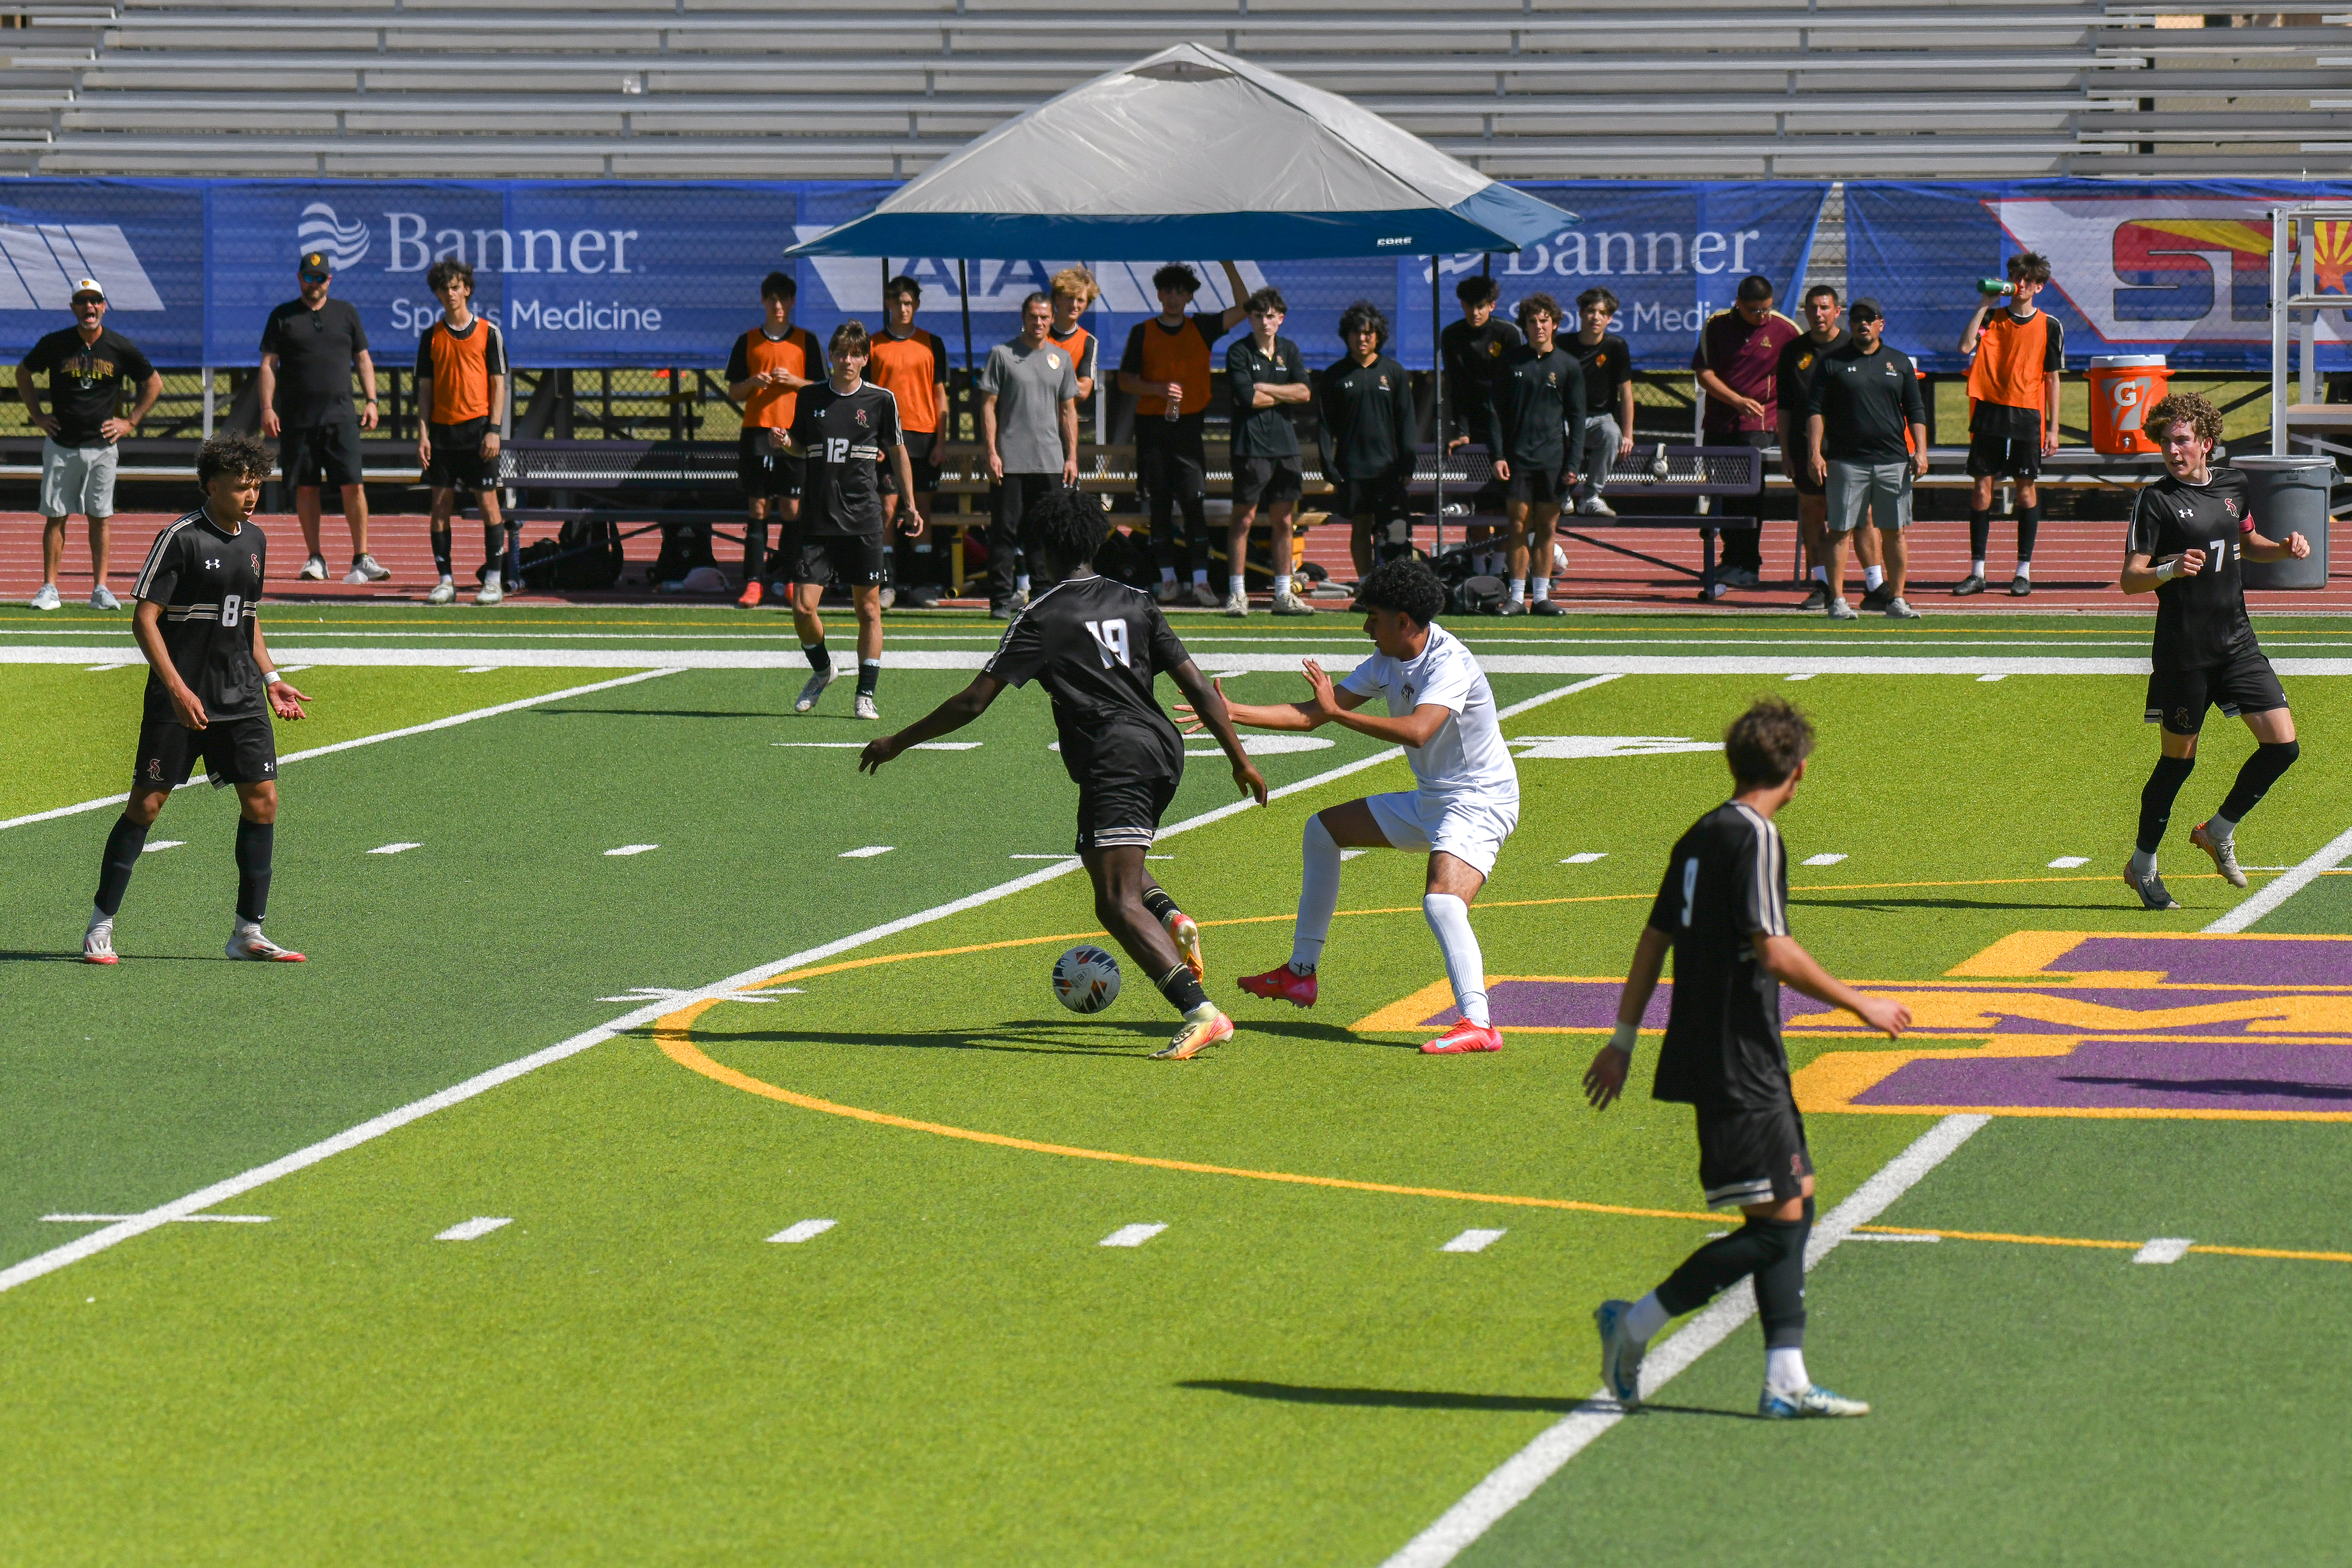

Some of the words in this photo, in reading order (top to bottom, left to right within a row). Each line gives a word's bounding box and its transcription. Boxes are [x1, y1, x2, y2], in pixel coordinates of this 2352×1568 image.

[383, 212, 639, 274] Banner
[1377, 237, 1413, 247] CORE
[1501, 230, 1760, 276] Banner
[511, 299, 662, 331] Medicine
[2114, 381, 2137, 407] G
[826, 437, 850, 463] 12
[2209, 539, 2226, 573] 7
[222, 595, 241, 627] 8
[1084, 618, 1132, 669] 19
[1681, 857, 1699, 928] 9
